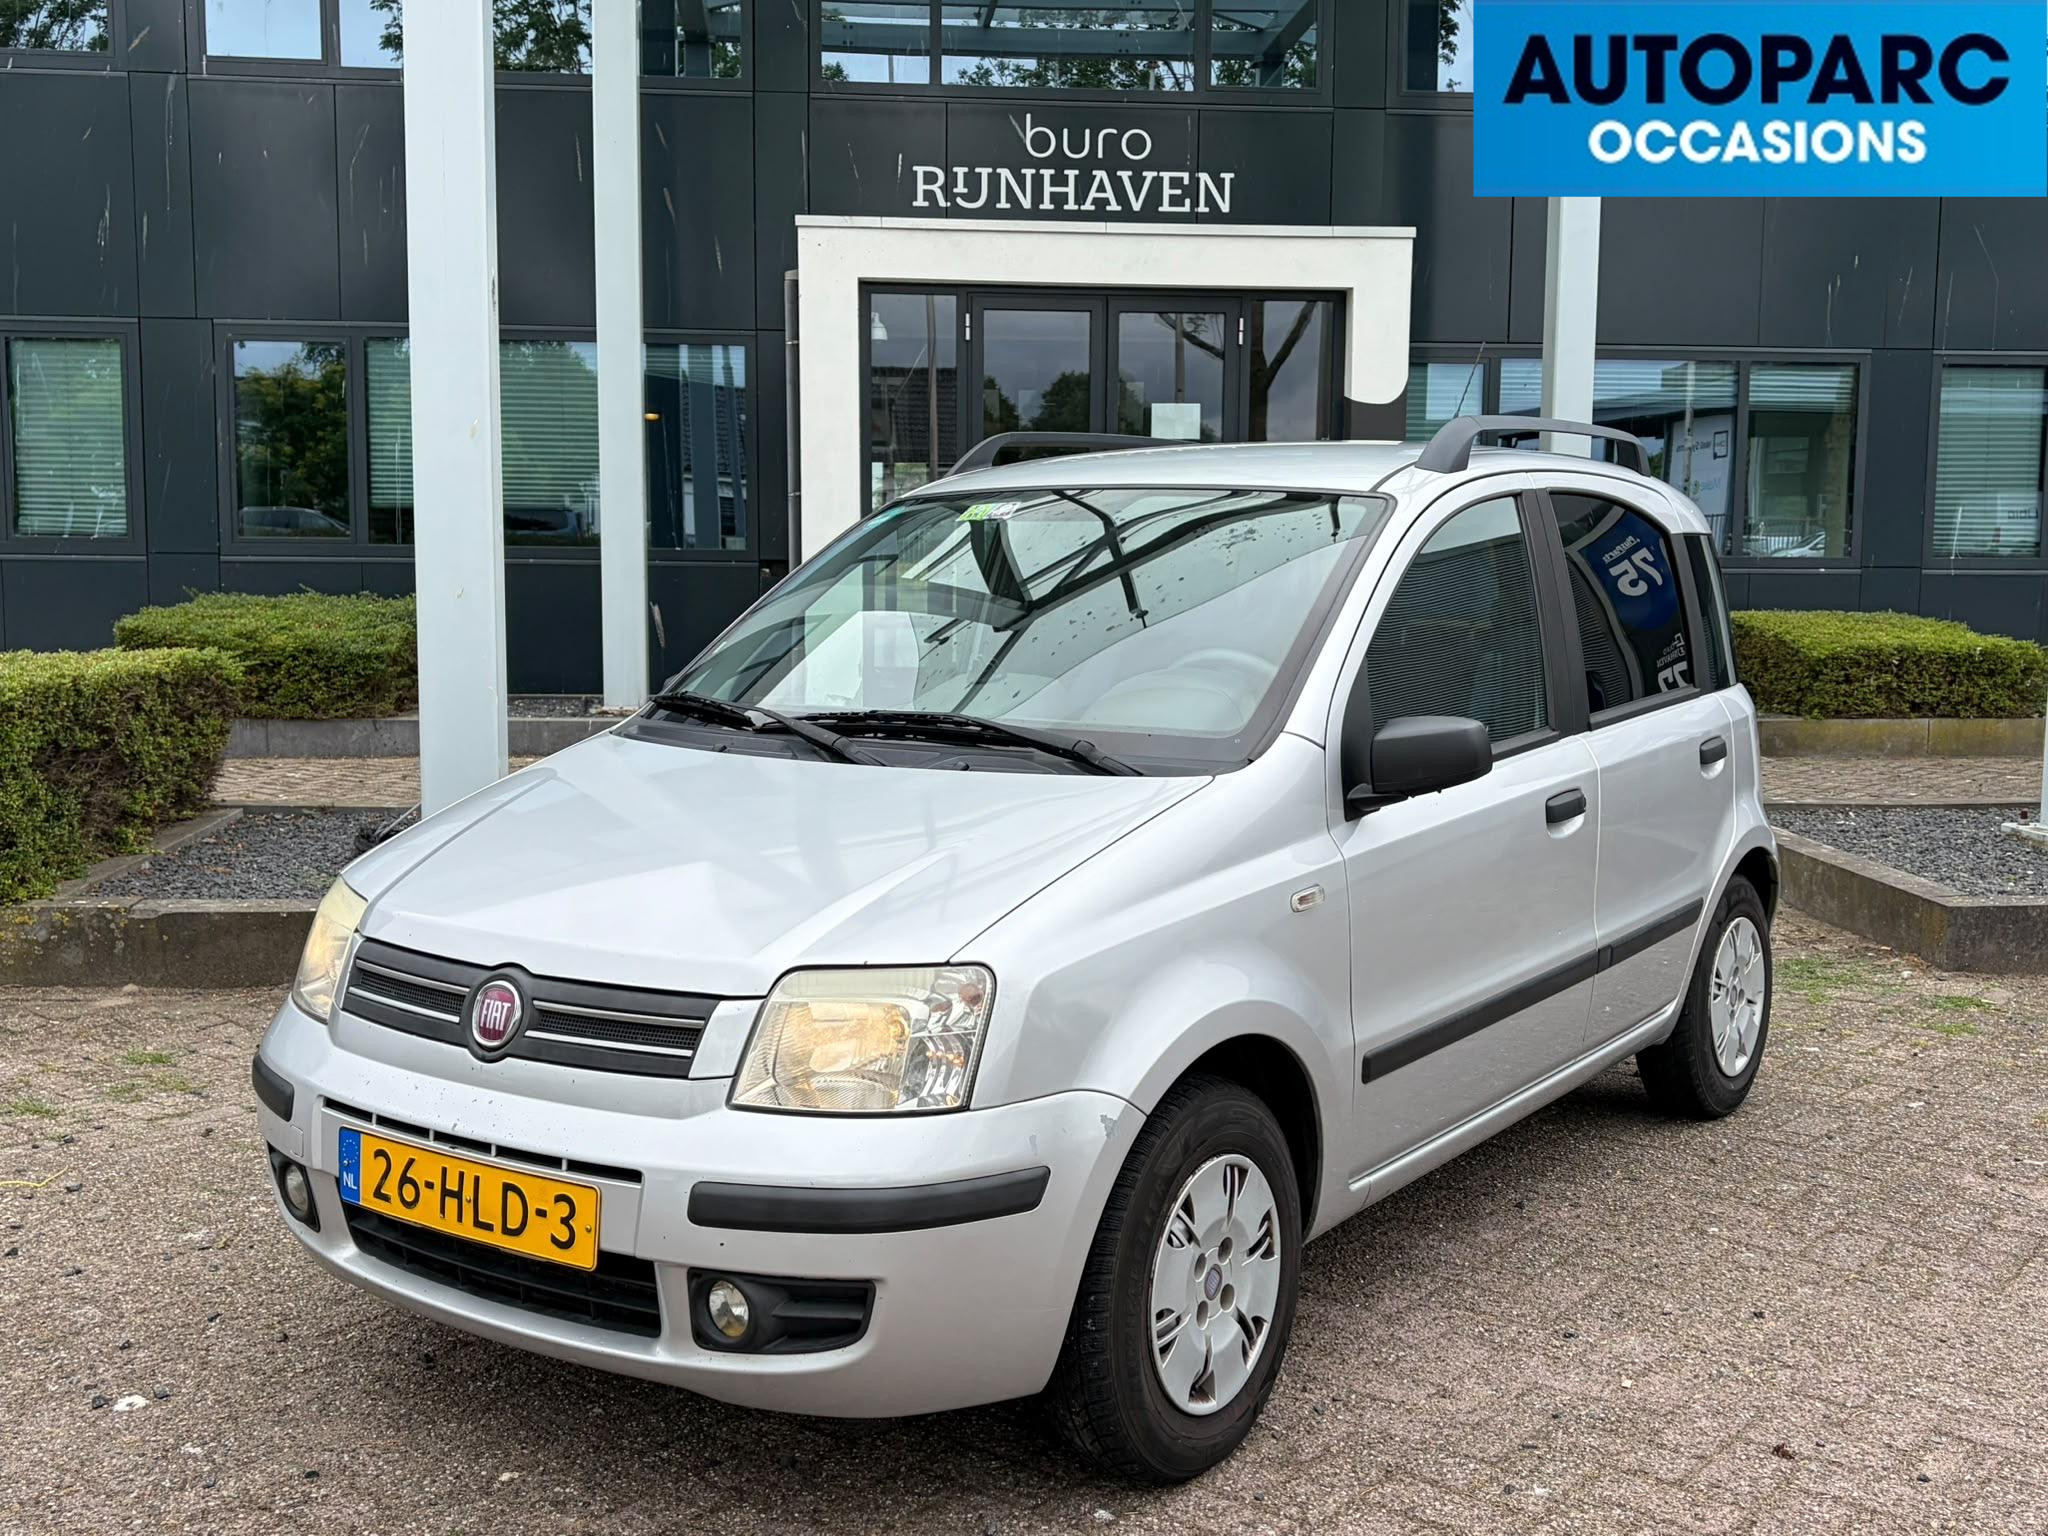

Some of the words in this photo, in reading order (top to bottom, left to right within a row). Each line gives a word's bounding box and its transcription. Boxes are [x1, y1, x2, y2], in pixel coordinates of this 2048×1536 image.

[1025, 113, 1152, 160] buro
[912, 165, 1235, 213] RIJNHAVEN
[480, 999, 511, 1031] FIAT
[343, 1171, 358, 1189] NL
[372, 1148, 577, 1250] 26-HLD-3
